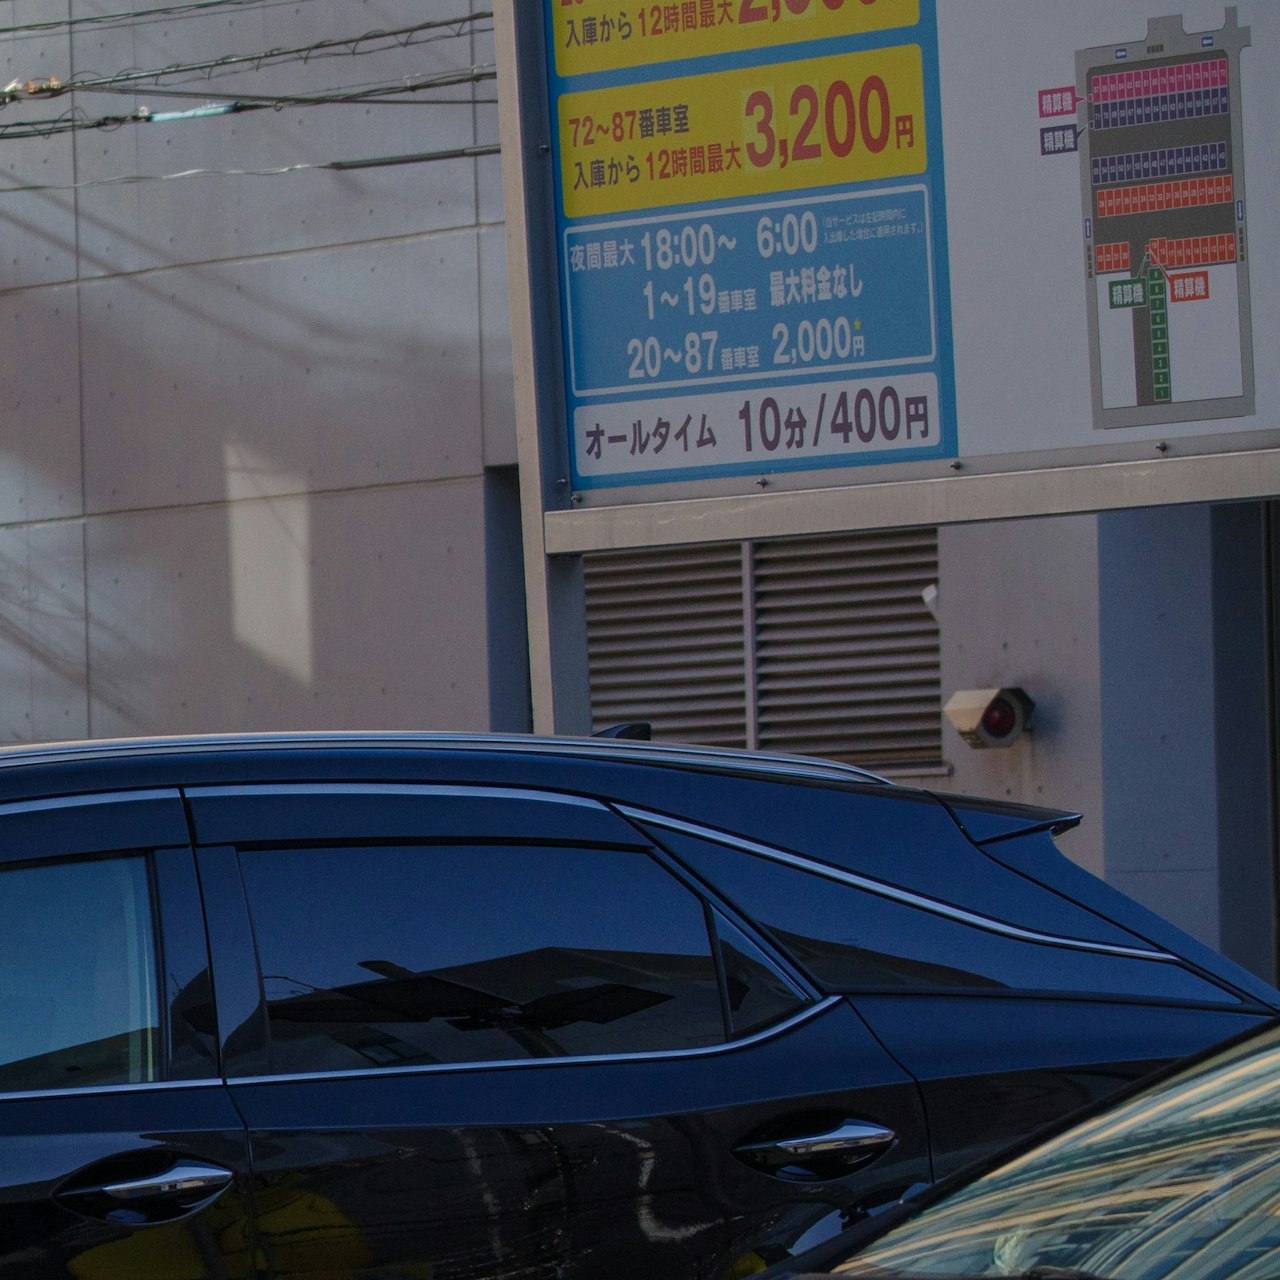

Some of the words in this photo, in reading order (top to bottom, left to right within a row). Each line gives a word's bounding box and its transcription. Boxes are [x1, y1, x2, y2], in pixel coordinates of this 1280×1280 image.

[744, 75, 914, 169] 3,200円
[1042, 91, 1072, 114] 精算機
[756, 211, 817, 257] 6:00
[770, 264, 863, 307] 最大料金なし
[1112, 283, 1144, 306] 精算機
[1173, 277, 1206, 300] 精算機
[772, 316, 865, 364] 2,000円
[586, 414, 717, 460] オールタイム
[738, 386, 929, 452] 10分/400円
